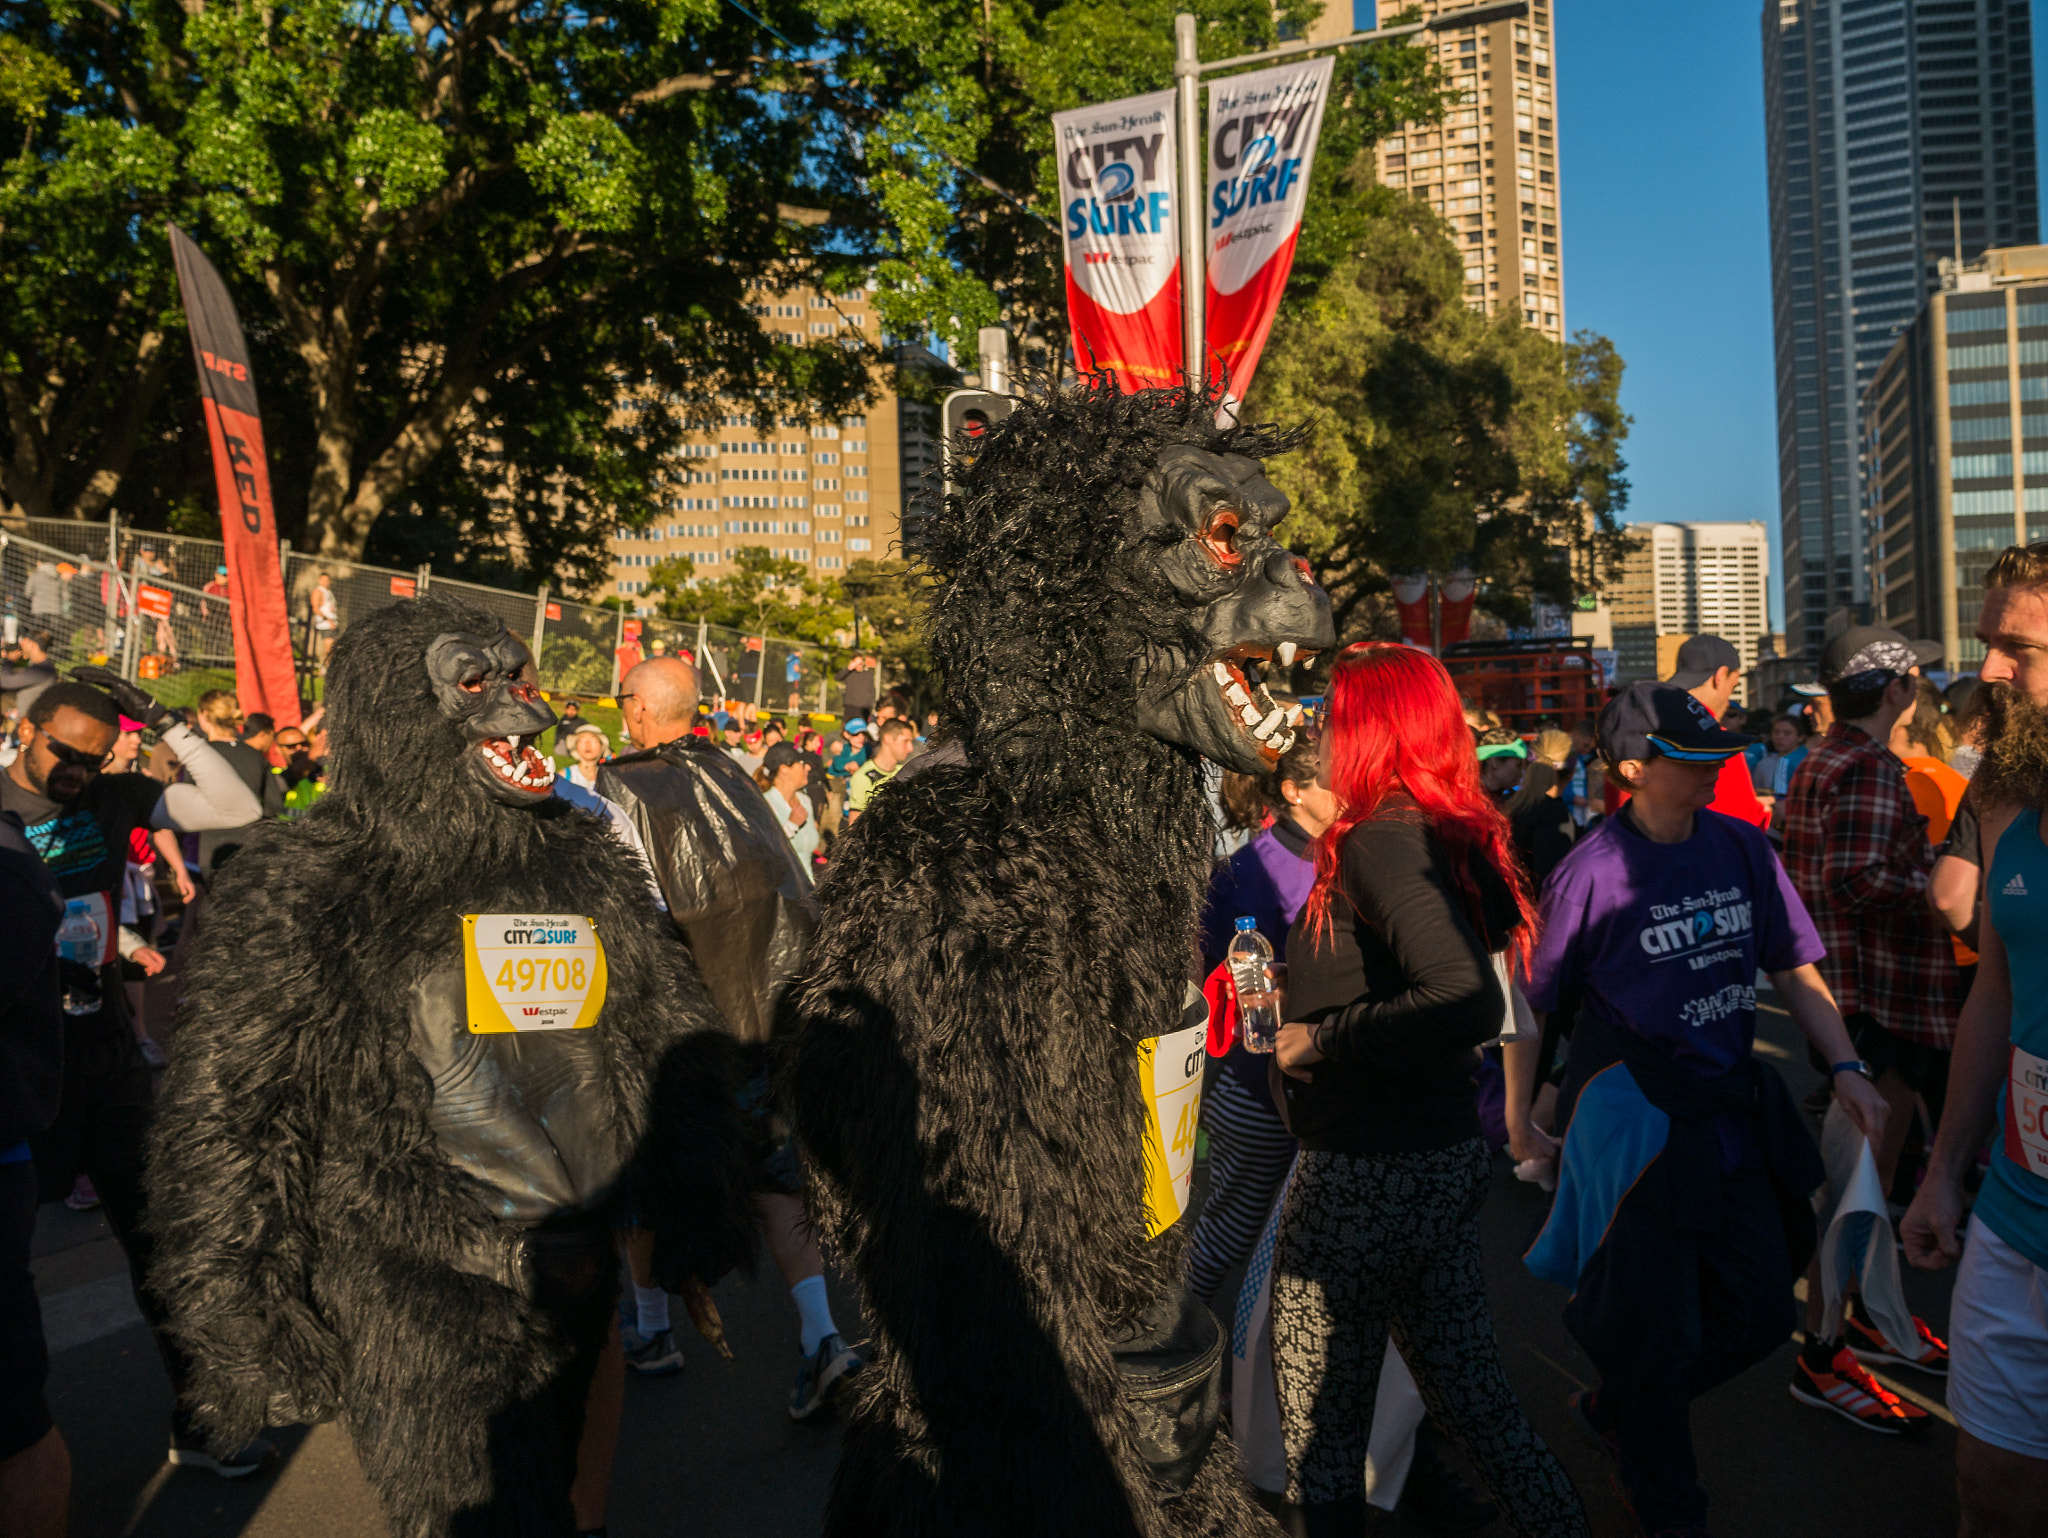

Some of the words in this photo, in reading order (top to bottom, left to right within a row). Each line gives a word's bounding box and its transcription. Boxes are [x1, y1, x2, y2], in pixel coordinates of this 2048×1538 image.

[1064, 125, 1087, 141] The
[1091, 110, 1167, 134] Sun-Herald
[1213, 100, 1314, 171] CITY
[1066, 133, 1165, 190] CITY
[1211, 157, 1302, 229] SURF
[1067, 191, 1170, 241] SURF
[1214, 221, 1274, 251] Westpac
[1083, 251, 1156, 266] Westpac
[1649, 903, 1680, 921] The
[1681, 886, 1742, 914] Sun-Herald
[513, 918, 528, 927] The
[529, 918, 570, 928] Sun-Herald
[495, 958, 586, 992] 49708
[1687, 948, 1744, 971] Westpac
[522, 1008, 568, 1017] Westpac
